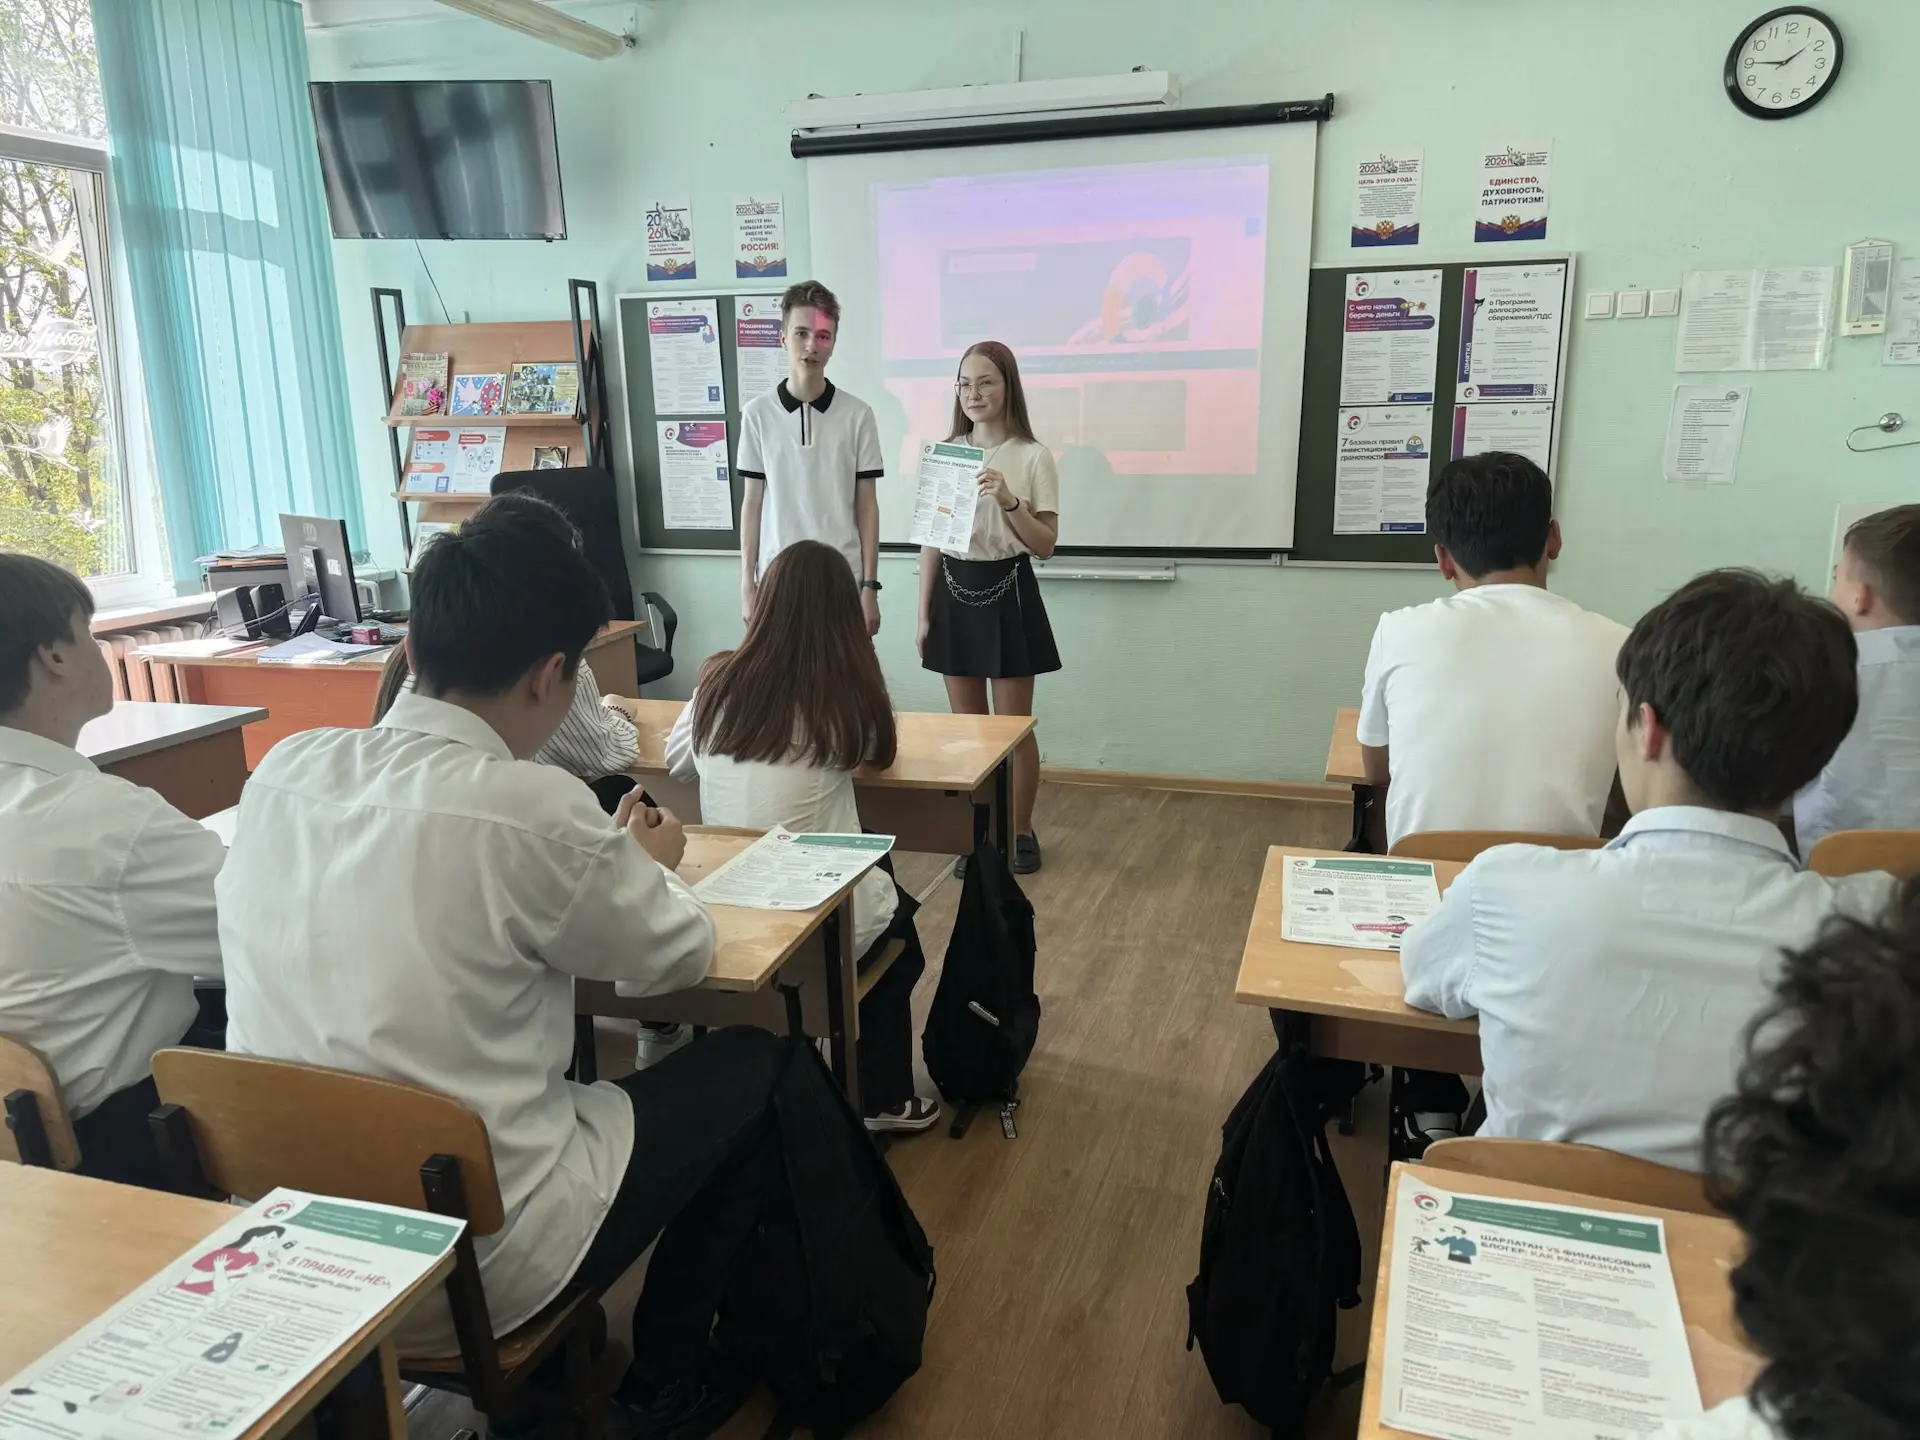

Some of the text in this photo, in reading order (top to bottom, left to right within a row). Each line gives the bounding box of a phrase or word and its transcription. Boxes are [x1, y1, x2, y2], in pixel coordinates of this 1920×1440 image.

[1769, 27, 1778, 39] 11
[1785, 22, 1799, 34] 12
[1807, 27, 1811, 38] 1
[1753, 40, 1766, 51] 10
[1813, 40, 1825, 51] 2
[1744, 58, 1754, 69] 9
[1814, 58, 1825, 69] 3
[1746, 75, 1756, 86] 8
[1806, 76, 1816, 86] 4
[1757, 88, 1767, 99] 7
[1771, 92, 1782, 103] 6
[1790, 88, 1800, 99] 5
[1485, 157, 1507, 166] 2026
[1359, 164, 1380, 173] 2026
[1489, 176, 1539, 186] ЕДИНСТВО,
[1482, 186, 1544, 197] ДУХОВНОСТЬ,
[1482, 196, 1544, 206] ПАТРИОТИЗМ!
[647, 214, 661, 227] 20
[648, 227, 661, 240] 26
[741, 242, 779, 251] РОССИЯ!
[1376, 311, 1400, 319] деньги
[1488, 306, 1539, 314] долгосрочных
[1488, 313, 1552, 322] сбережений/ПДС
[1341, 438, 1348, 447] 7
[1480, 1234, 1652, 1270] ШАРЛАТАН VS ФИНАНСОВЫЙ
[287, 1256, 297, 1266] 5
[298, 1258, 356, 1279] ПРАВИЛ
[1530, 1251, 1554, 1261] КАК
[1556, 1256, 1635, 1275] РАСПОЗНАТЬ
